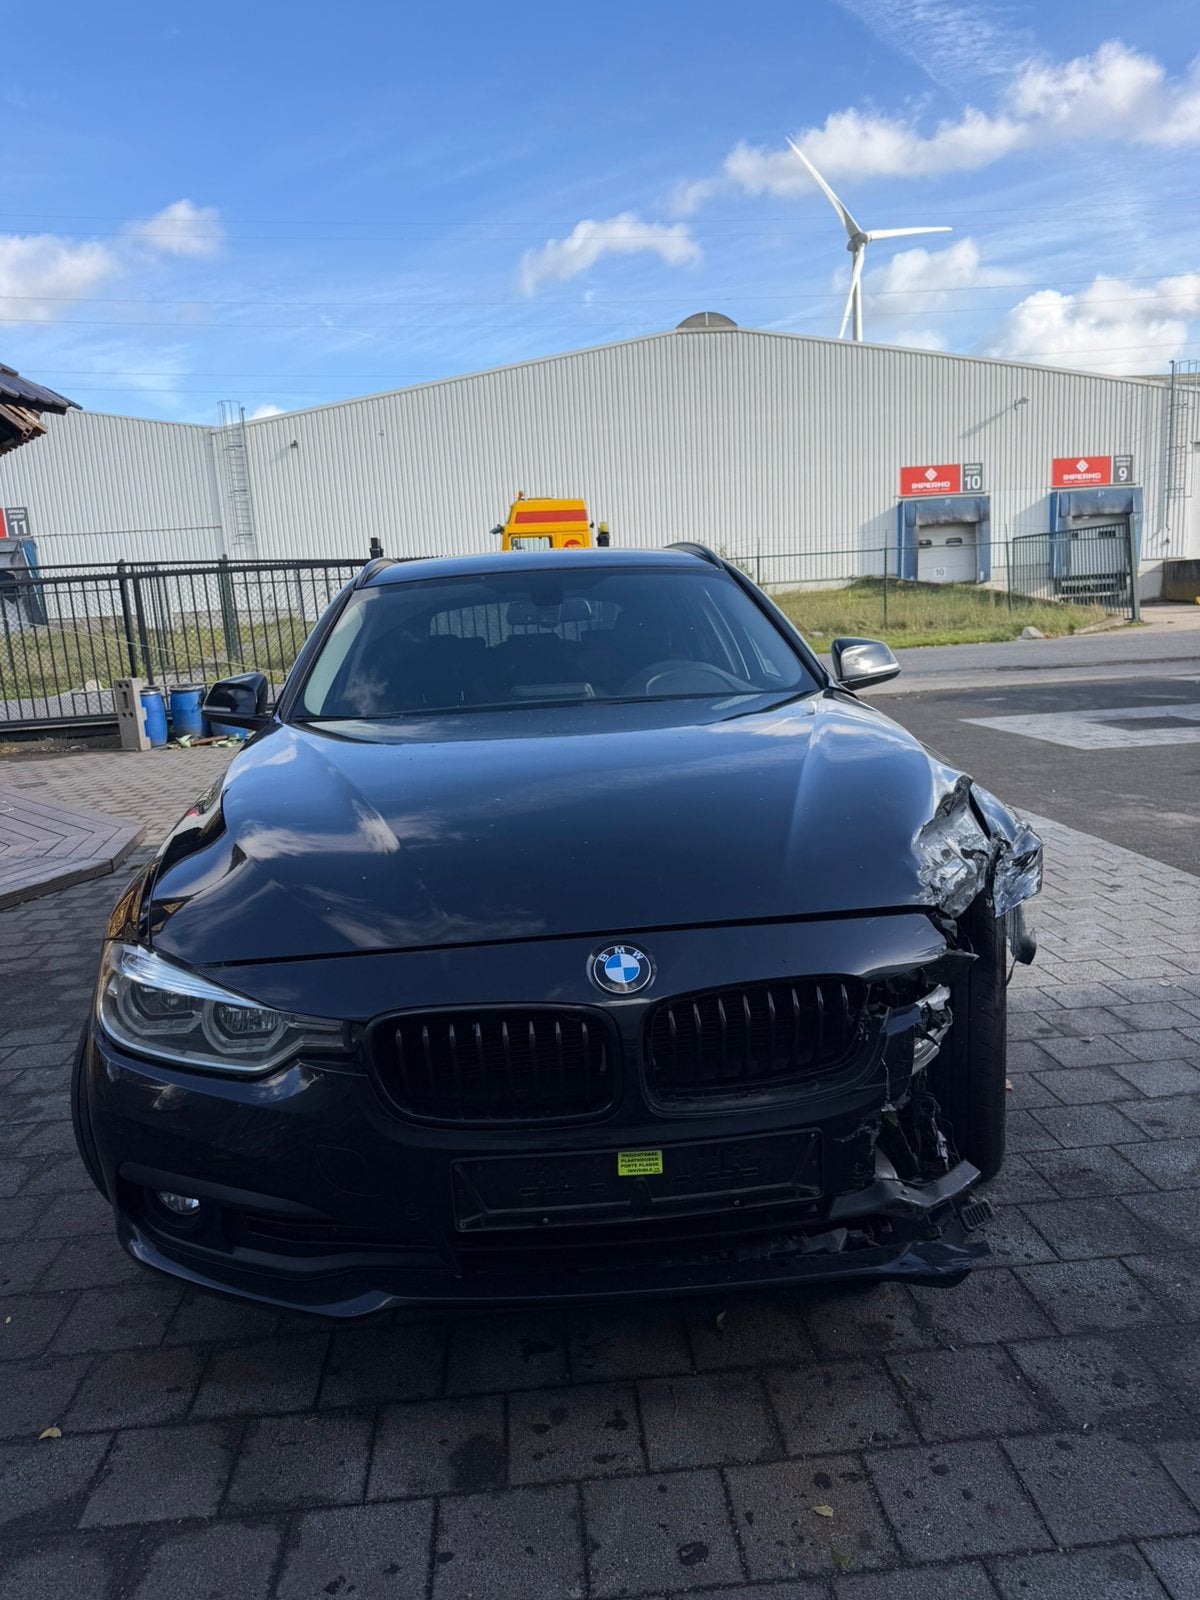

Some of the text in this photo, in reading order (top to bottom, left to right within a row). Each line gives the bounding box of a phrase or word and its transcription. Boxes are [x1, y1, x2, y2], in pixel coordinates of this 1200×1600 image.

[1063, 472, 1102, 480] IMPERMO
[1118, 467, 1128, 481] 9
[911, 481, 951, 490] IMPERMO
[964, 475, 981, 490] 10
[10, 520, 28, 535] 11
[936, 568, 945, 576] 10
[598, 946, 644, 962] BMW
